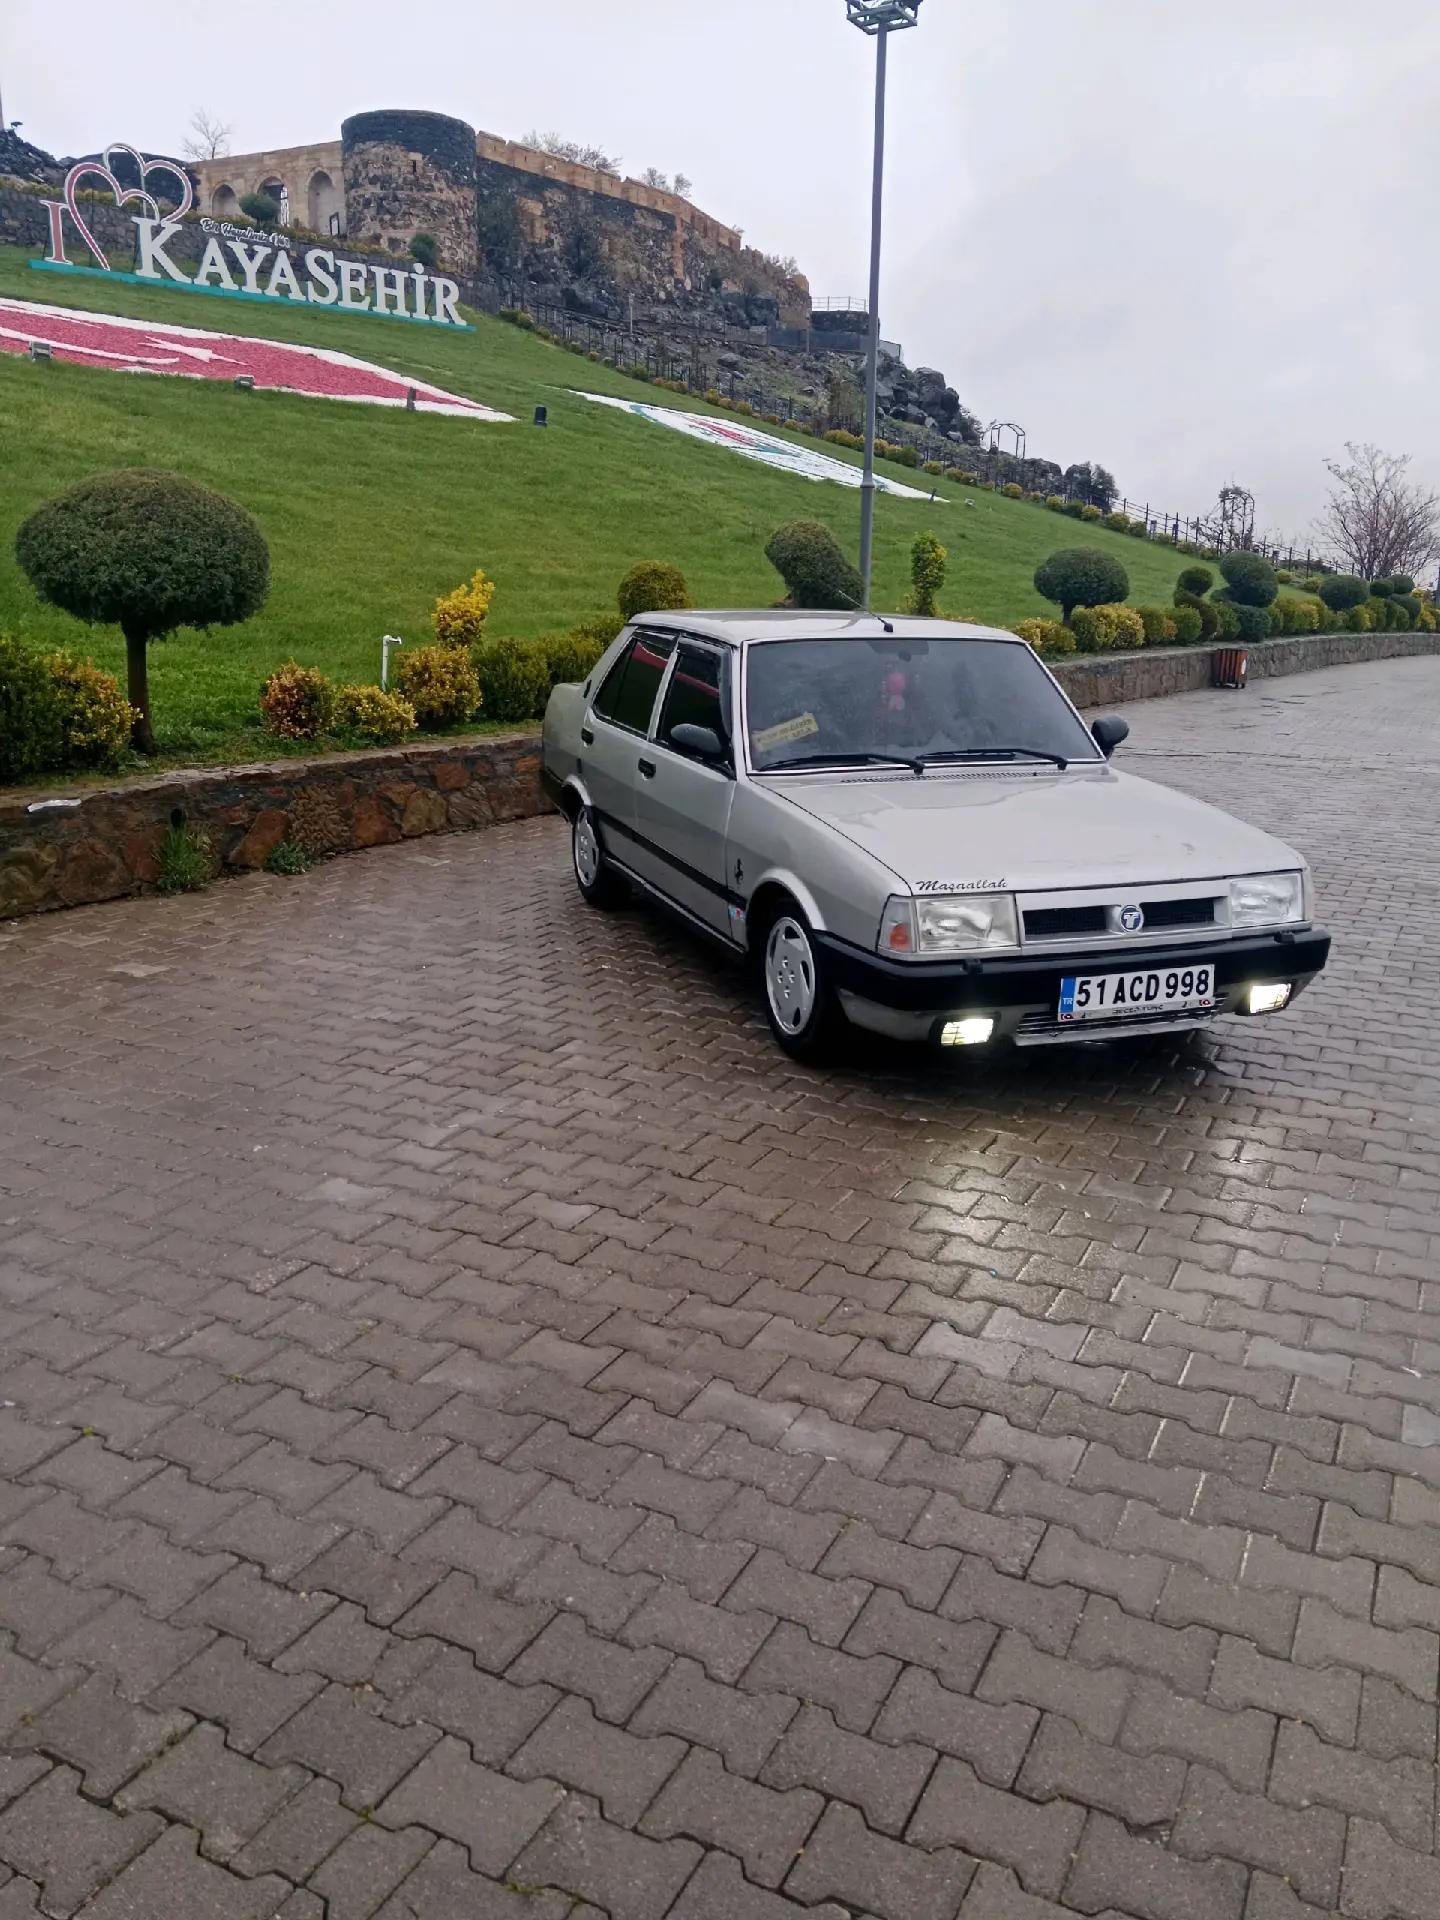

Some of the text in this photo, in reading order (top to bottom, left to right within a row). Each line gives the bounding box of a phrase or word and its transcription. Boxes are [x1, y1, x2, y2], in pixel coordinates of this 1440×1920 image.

[1076, 969, 1210, 1007] 51 ACD 998
